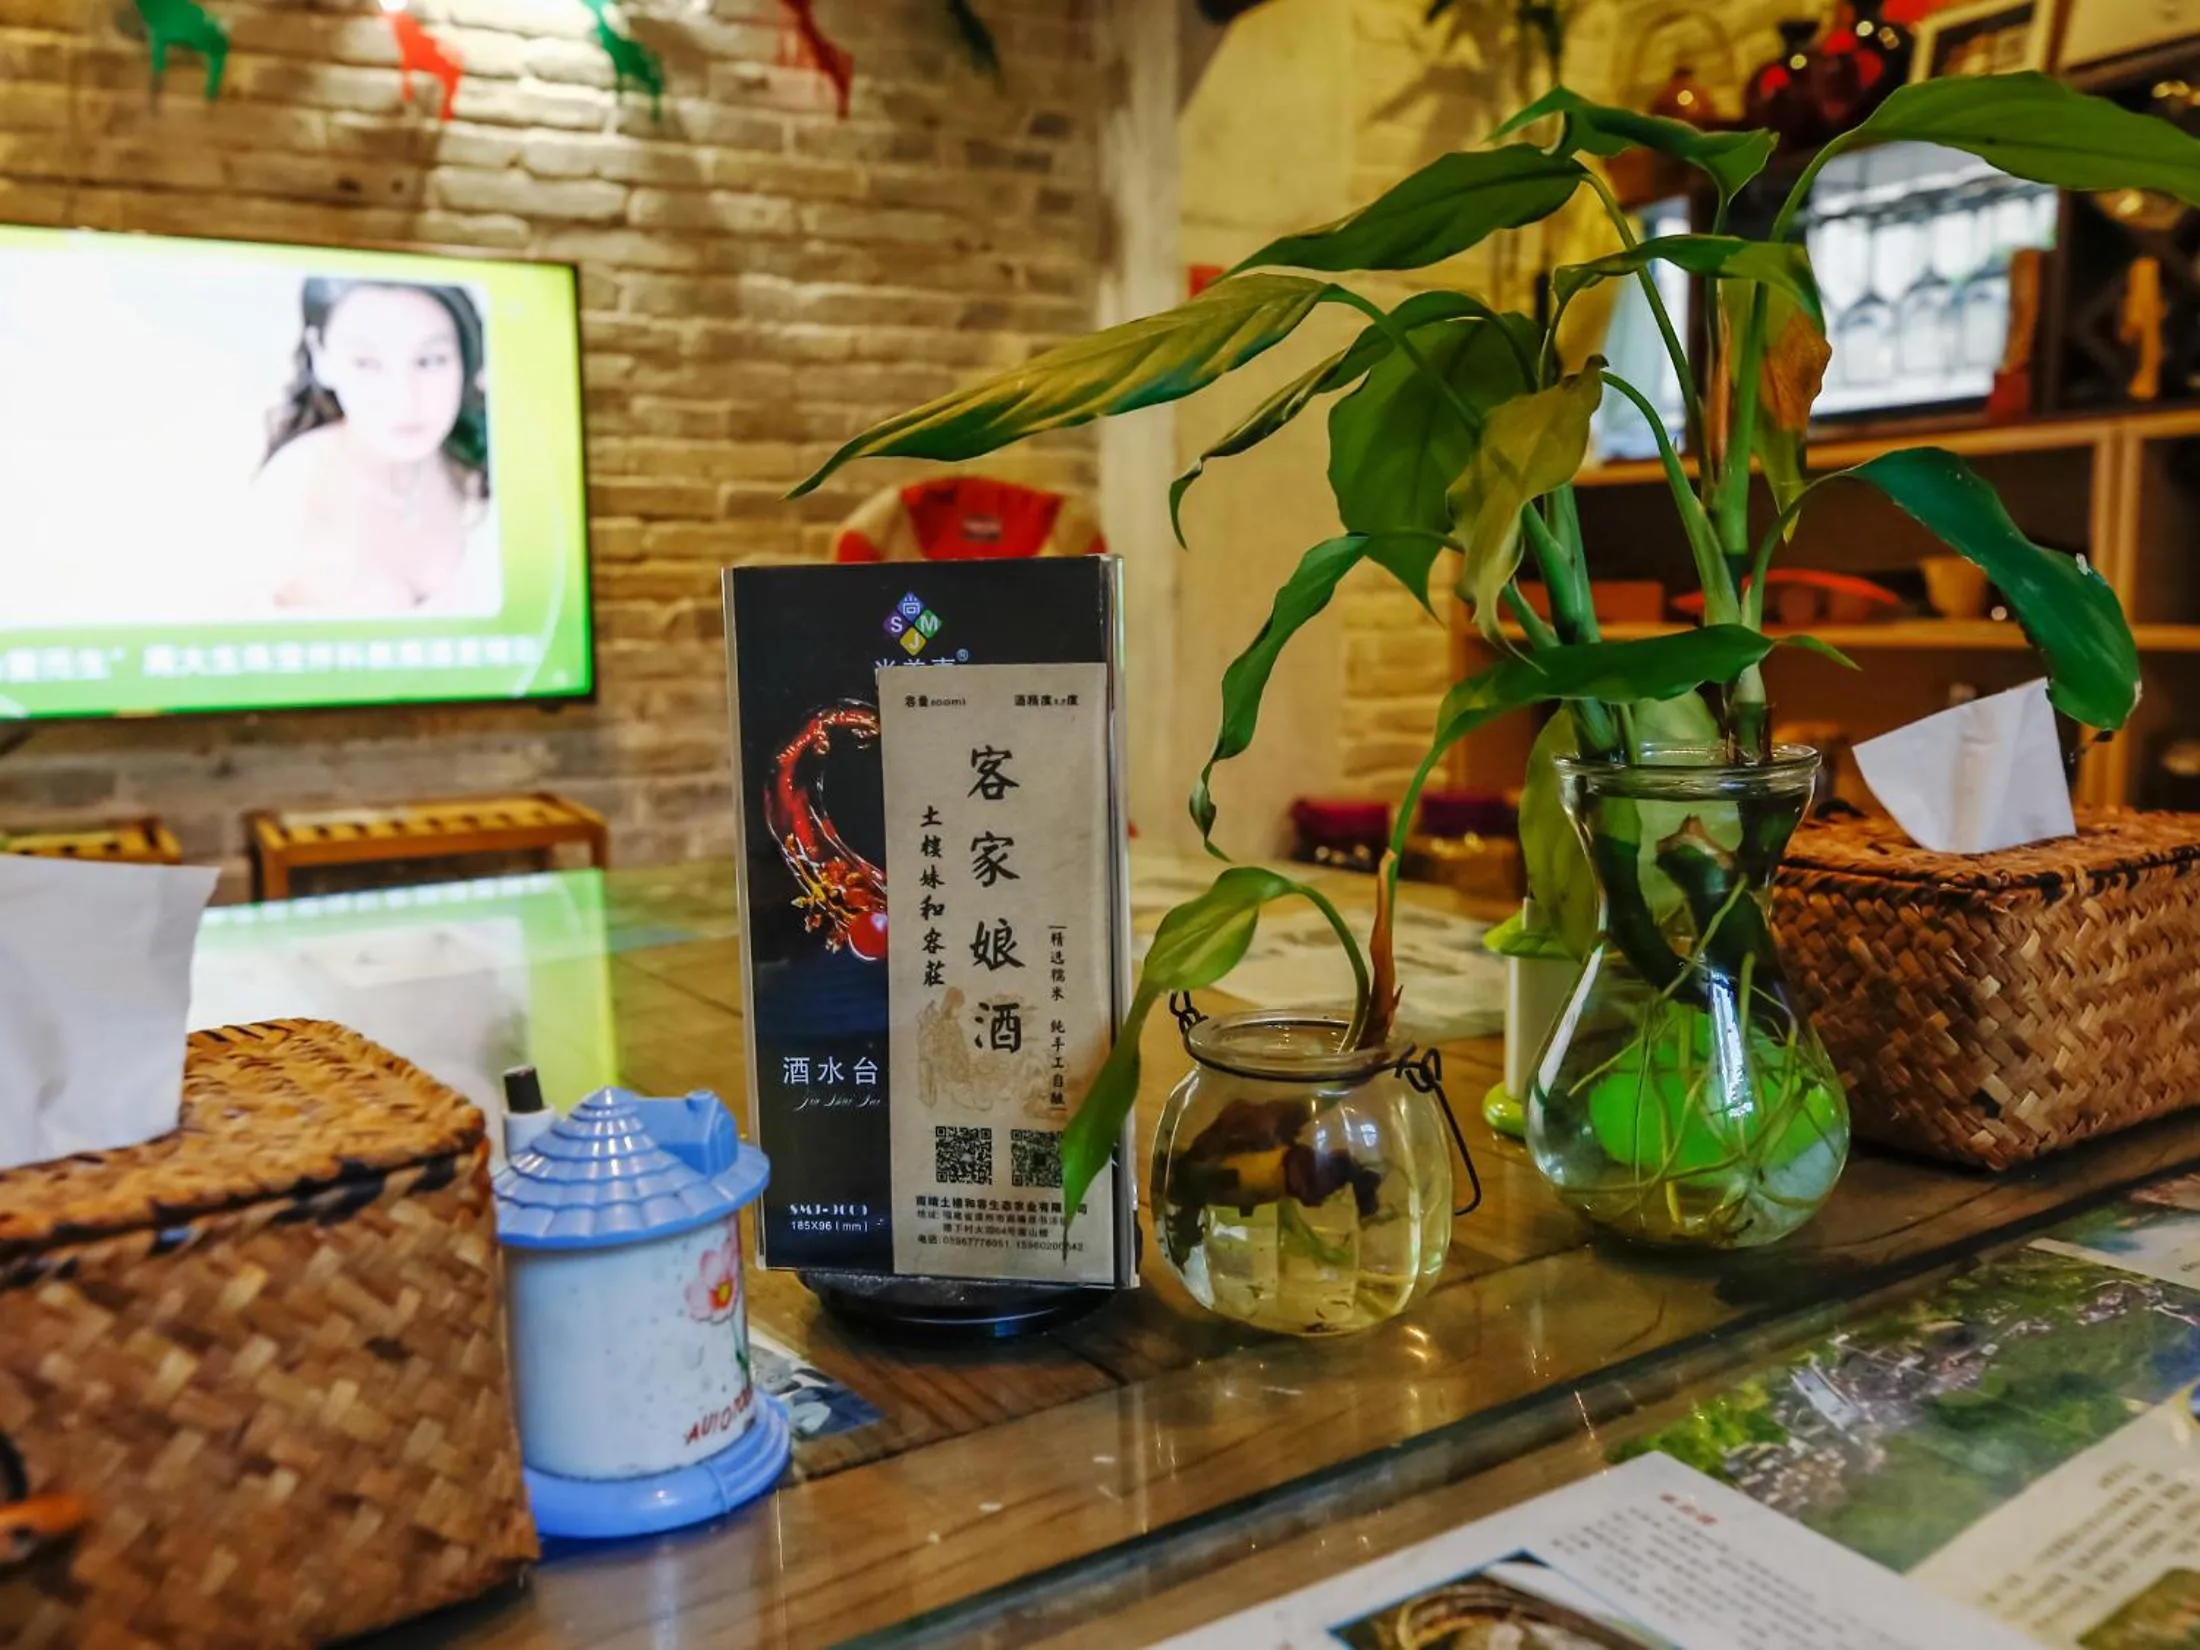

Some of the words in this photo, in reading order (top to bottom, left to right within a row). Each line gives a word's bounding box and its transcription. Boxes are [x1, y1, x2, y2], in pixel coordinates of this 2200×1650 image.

[967, 744, 1026, 1054] 客家娘酒
[783, 1056, 878, 1085] 酒水台
